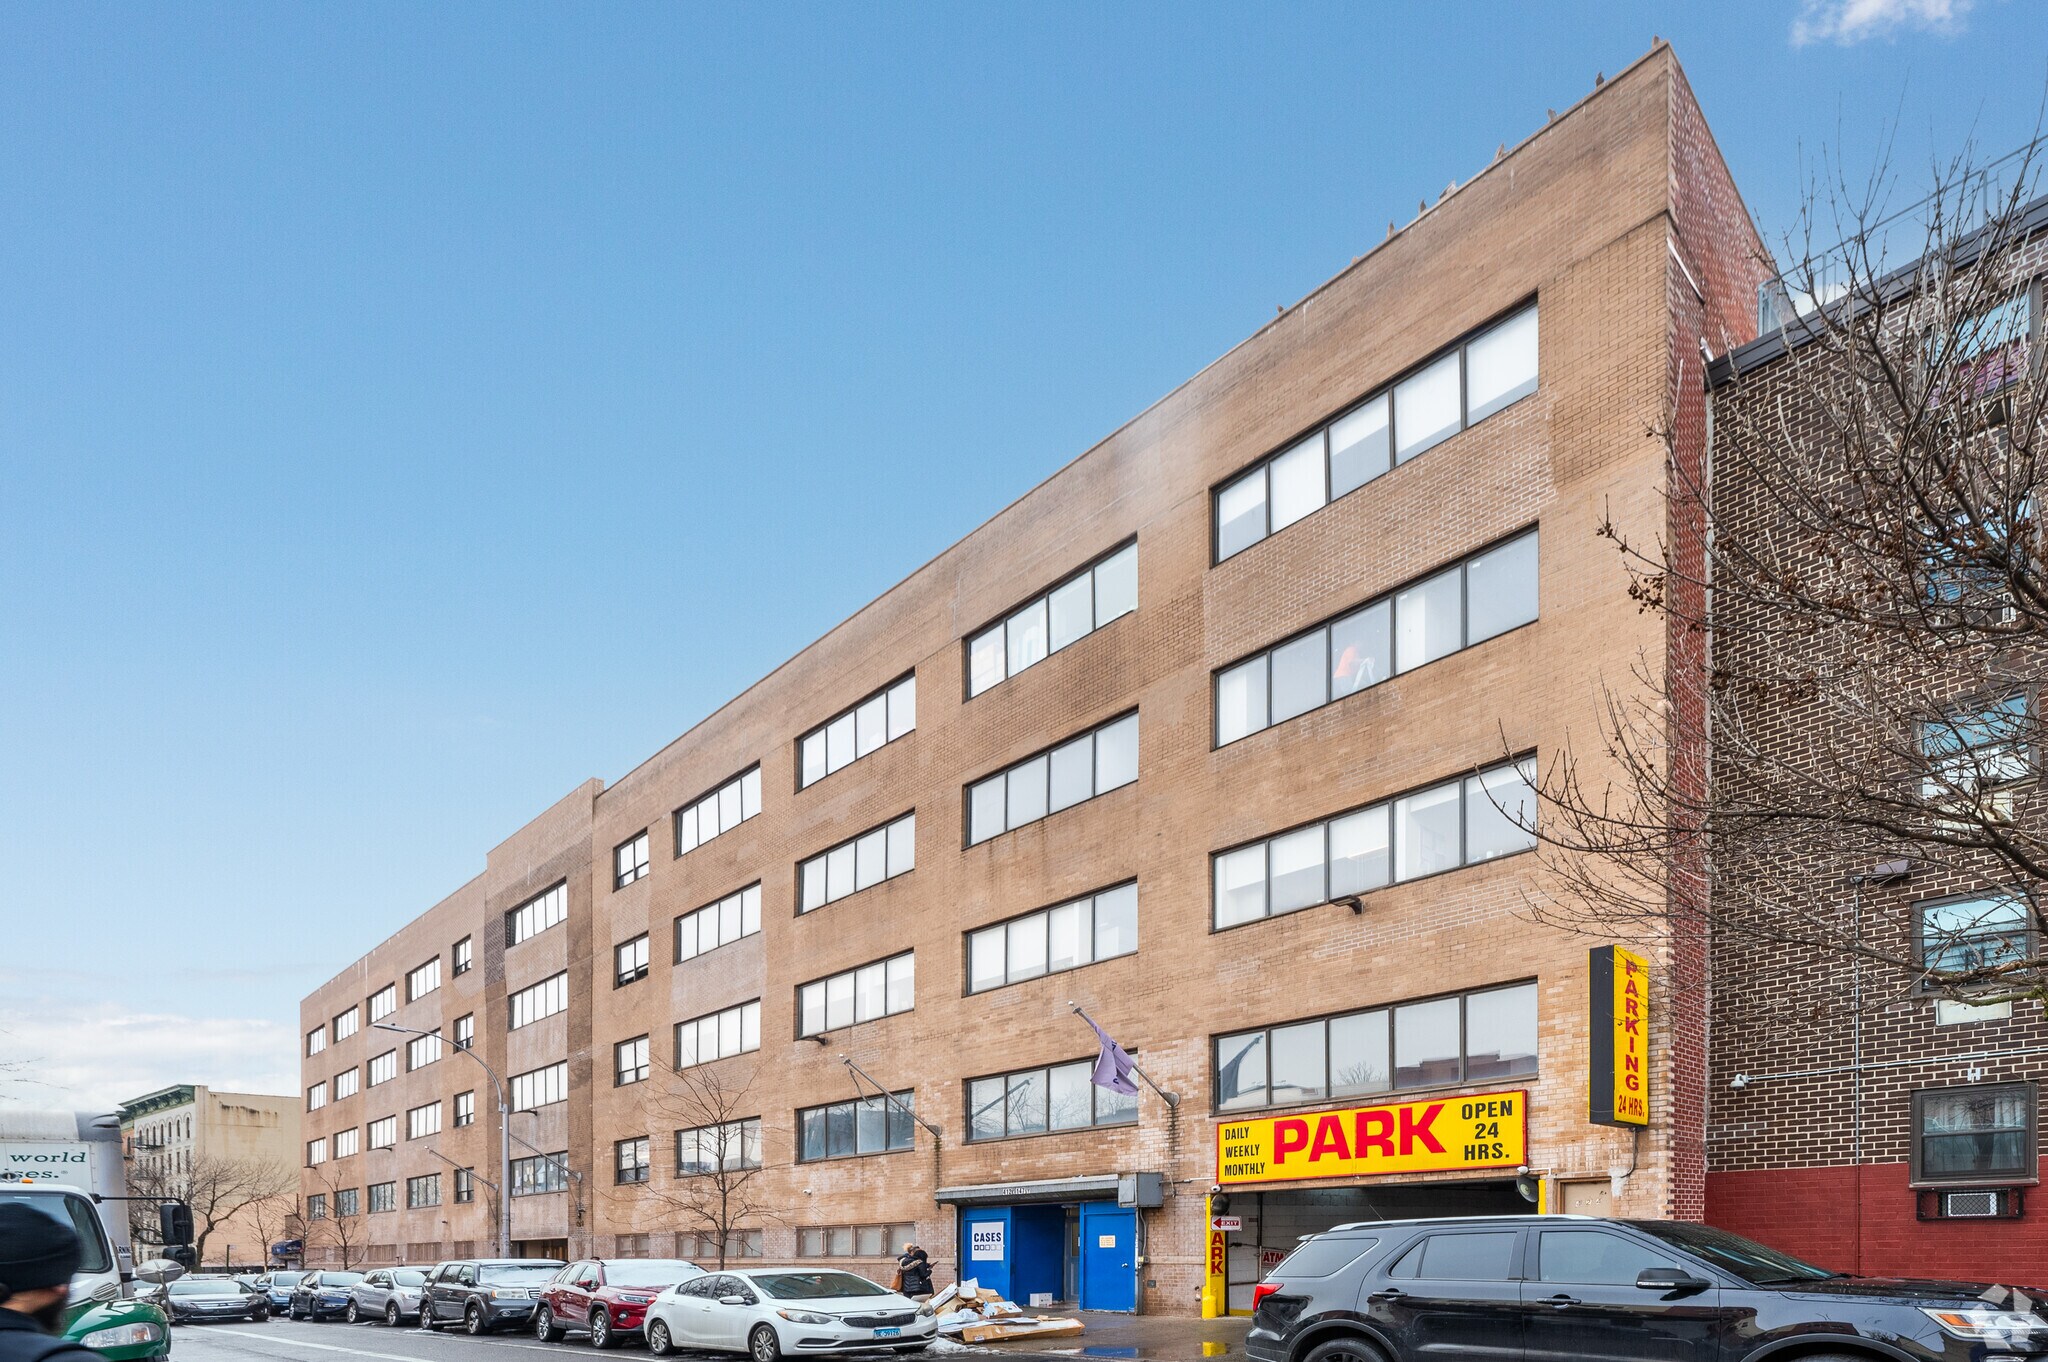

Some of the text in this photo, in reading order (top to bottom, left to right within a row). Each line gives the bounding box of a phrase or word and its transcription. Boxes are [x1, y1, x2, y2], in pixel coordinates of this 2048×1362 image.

[1624, 959, 1640, 1092] PARKING
[1461, 1099, 1513, 1121] OPEN
[1618, 1094, 1645, 1118] 24 HRS.
[1224, 1126, 1250, 1141] DAILY
[1273, 1103, 1448, 1165] PARK
[1474, 1121, 1499, 1140] 24
[10, 1151, 87, 1163] world
[1225, 1143, 1260, 1159] WEEKLY
[1464, 1142, 1510, 1161] HRS.
[1224, 1161, 1266, 1177] MONTHLY
[1221, 1219, 1238, 1227] EXIT
[973, 1232, 1002, 1243] CASES
[1211, 1231, 1224, 1275] ARK
[1263, 1251, 1285, 1263] ATM
